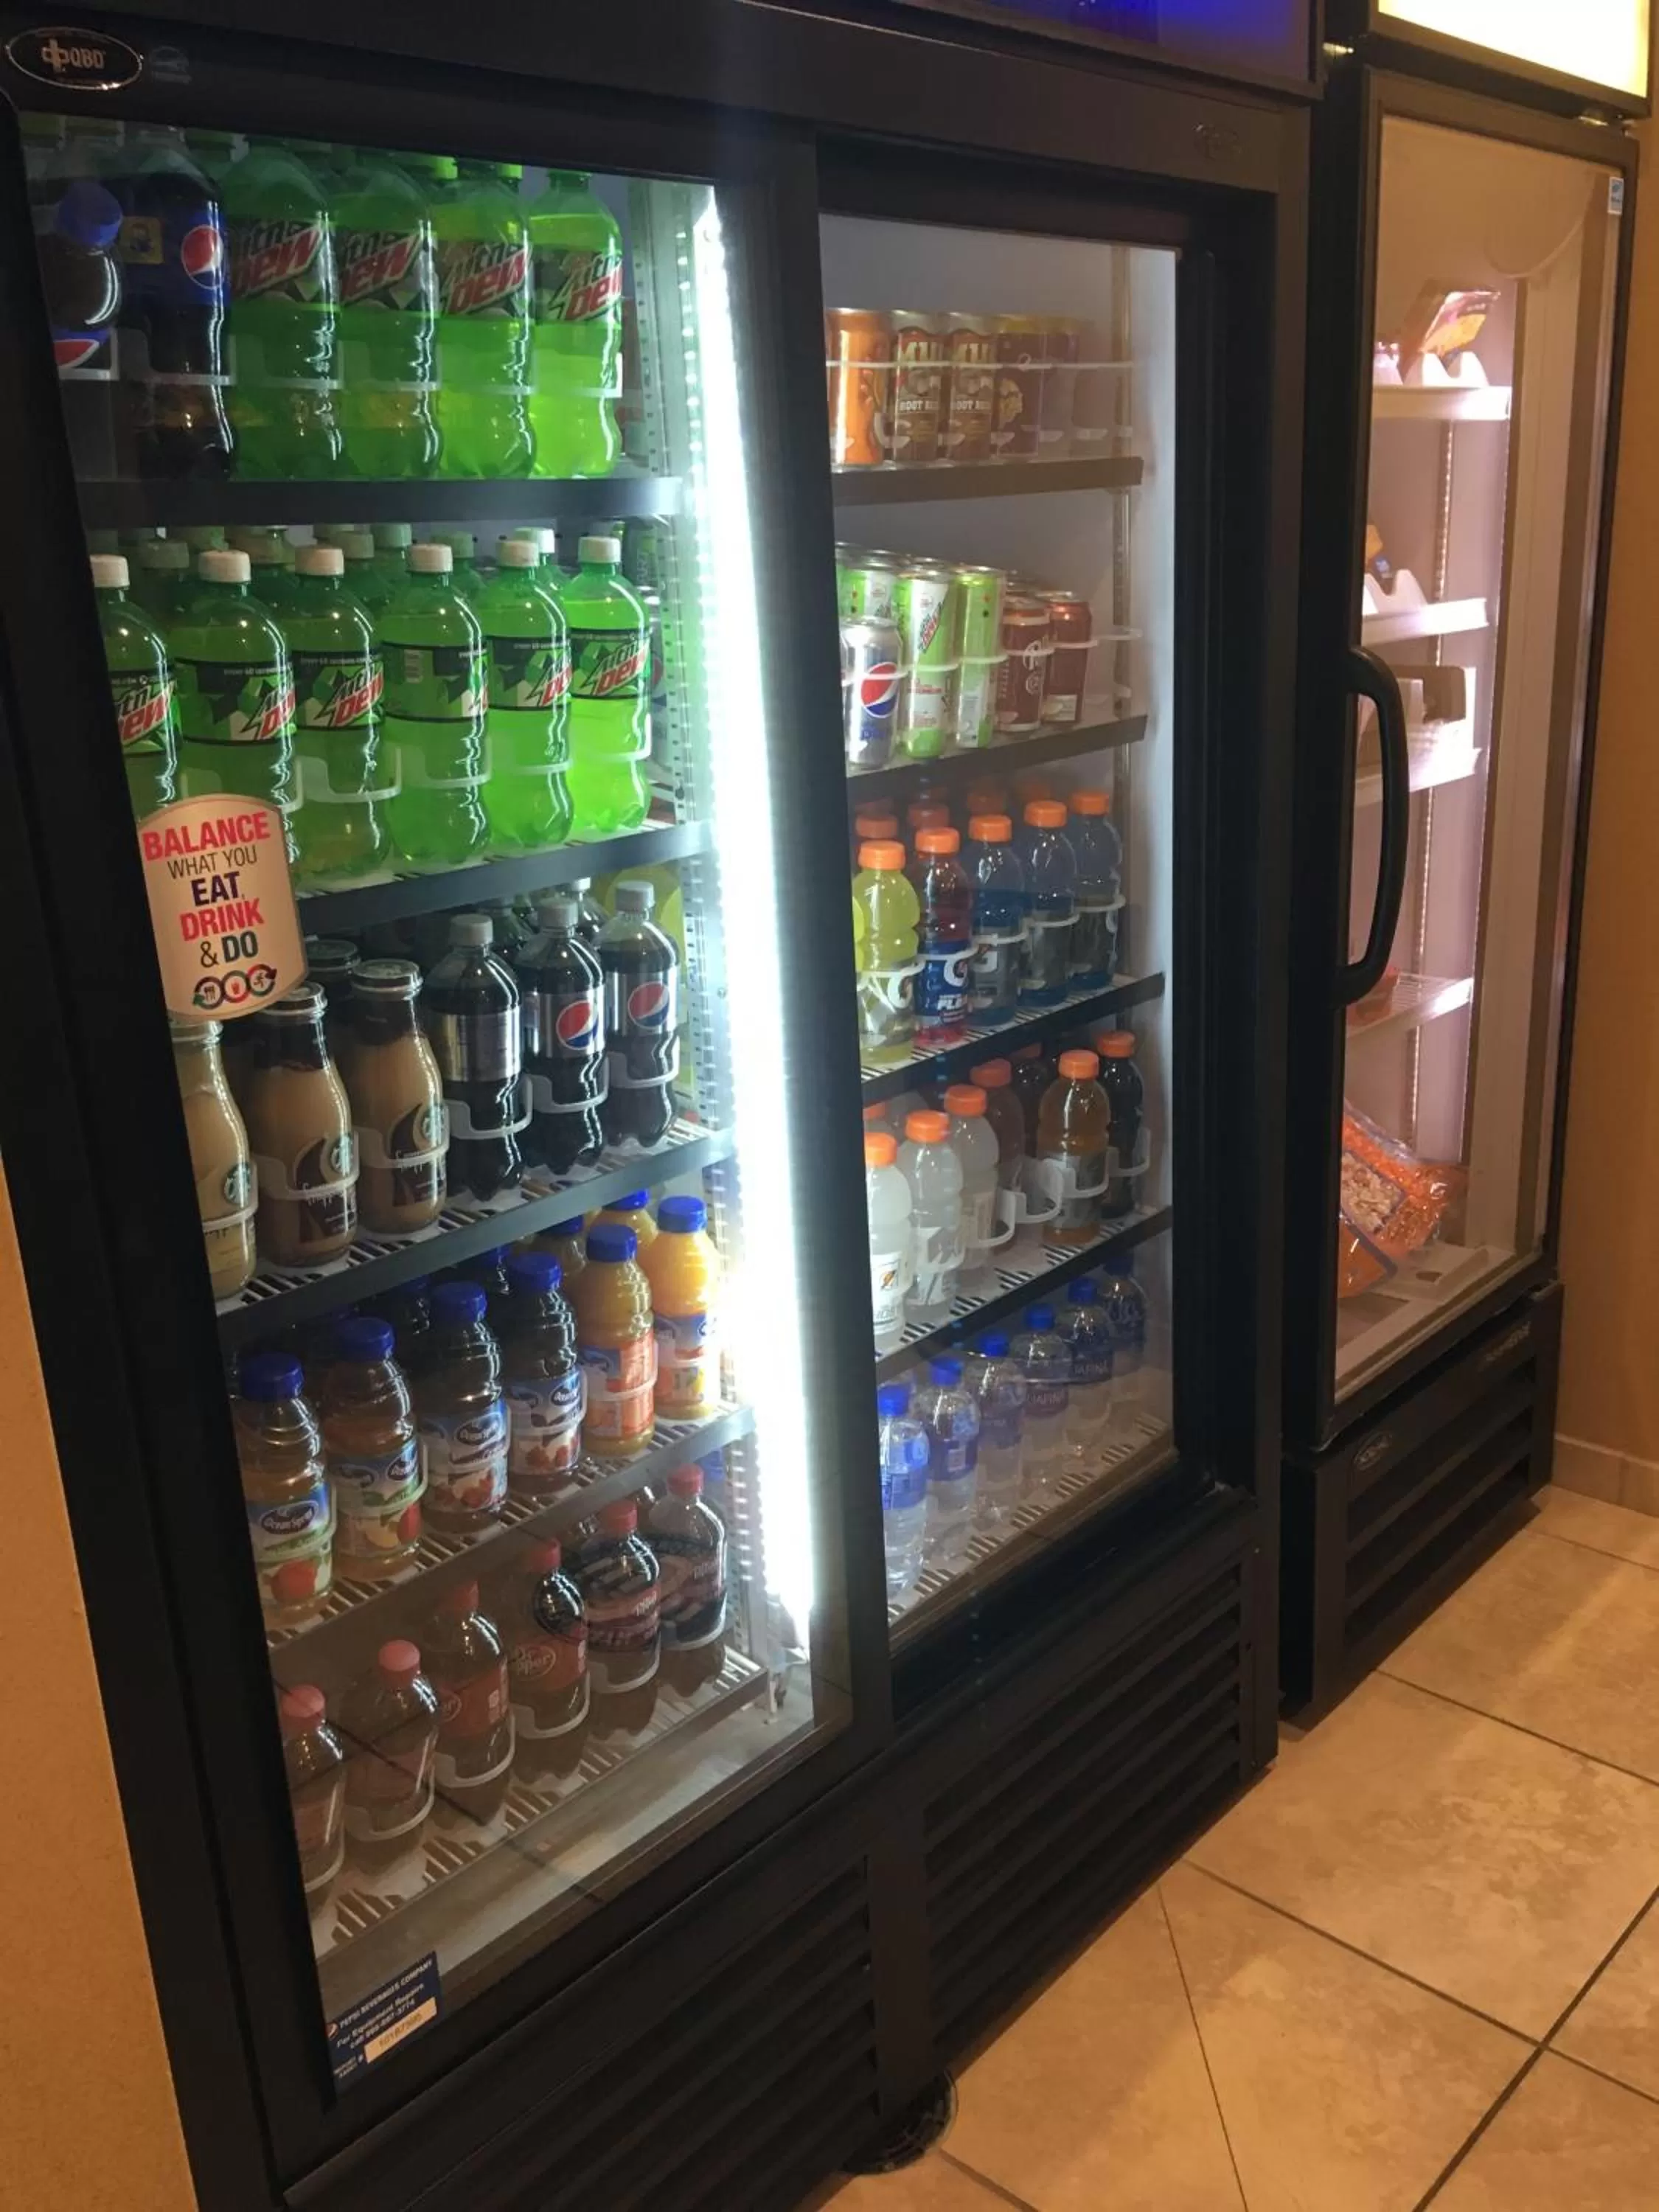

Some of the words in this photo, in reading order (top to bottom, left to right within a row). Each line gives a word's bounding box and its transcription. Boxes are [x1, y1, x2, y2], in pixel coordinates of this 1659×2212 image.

[142, 812, 271, 861] BALANCE
[167, 852, 218, 879] WHAT
[223, 844, 258, 870] YOU
[179, 898, 265, 942] DRINK
[200, 941, 220, 968] &
[222, 931, 259, 963] DO
